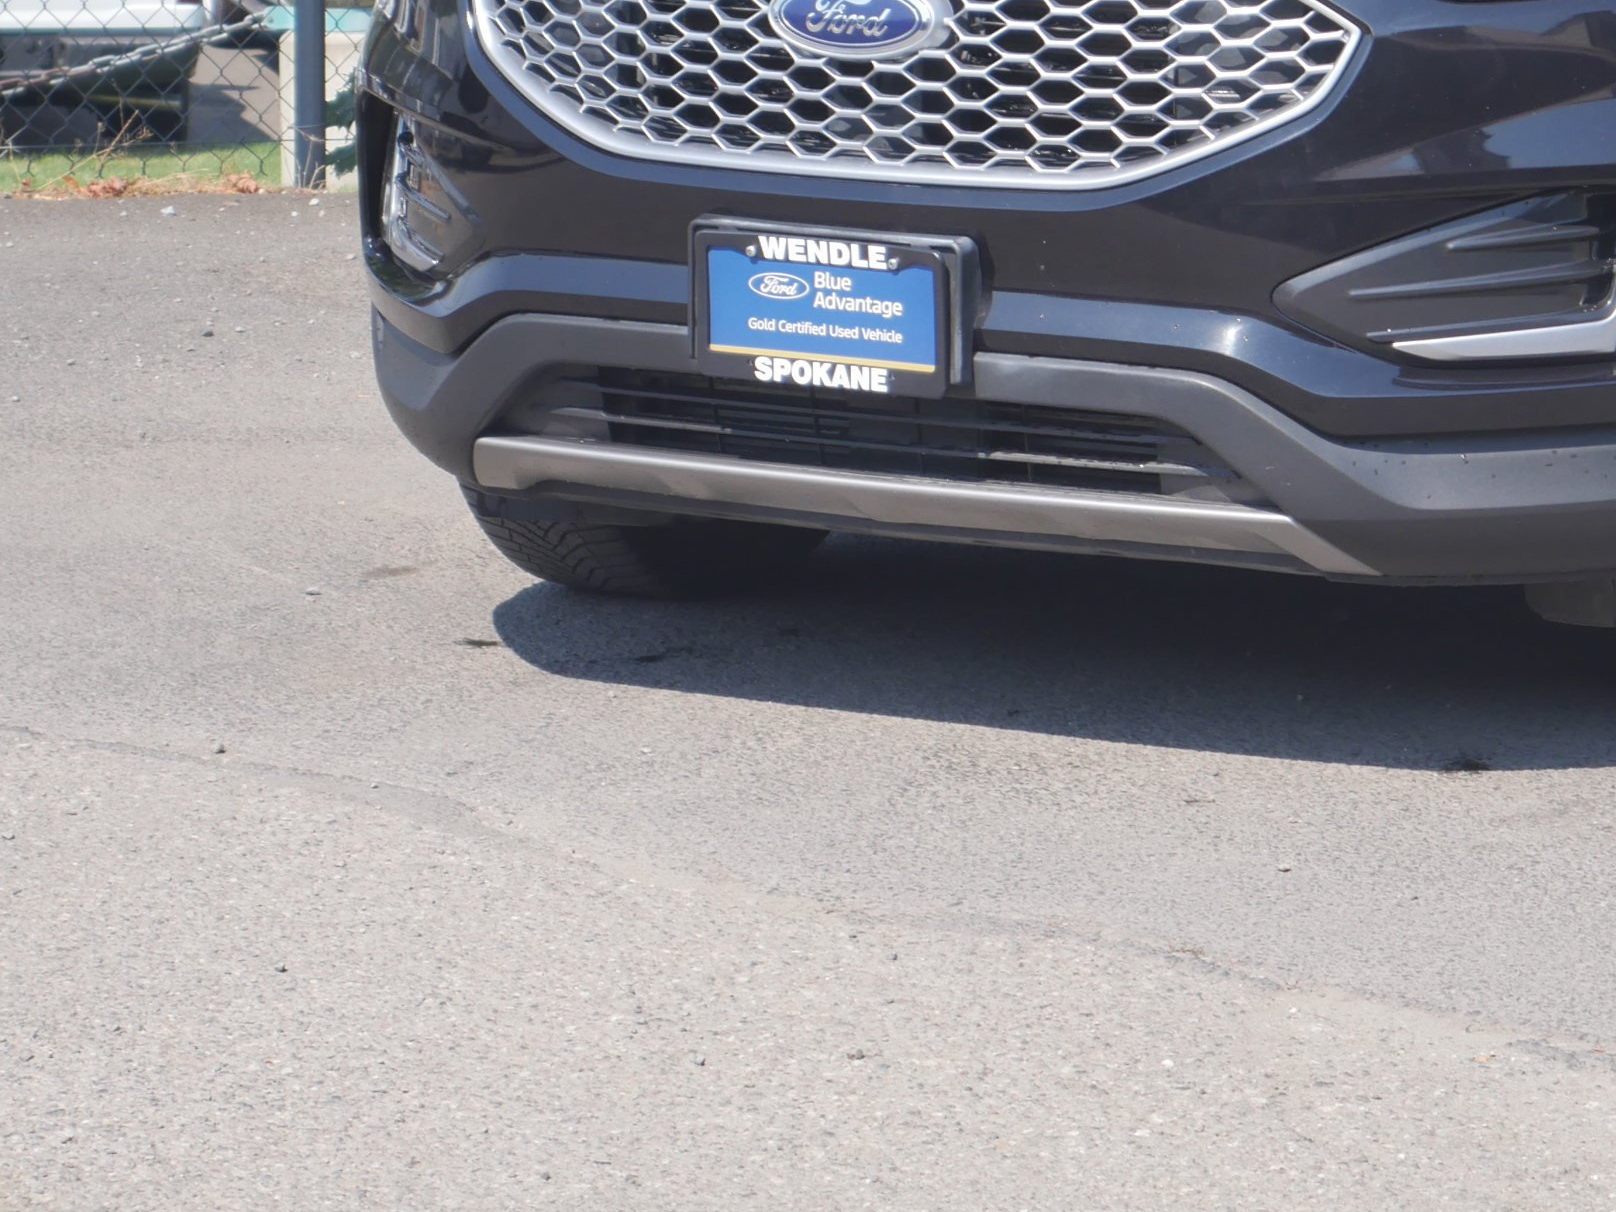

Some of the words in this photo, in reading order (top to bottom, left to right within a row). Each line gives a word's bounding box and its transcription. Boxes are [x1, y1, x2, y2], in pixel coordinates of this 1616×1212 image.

[758, 236, 888, 269] WENDLE
[760, 275, 798, 296] Ford
[814, 271, 852, 290] Blue
[813, 292, 903, 317] Advantage
[748, 317, 776, 331] Gold
[778, 320, 827, 336] Certified
[829, 324, 859, 339] Used
[862, 328, 903, 343] Vehicle
[754, 356, 888, 392] SPOKANE
